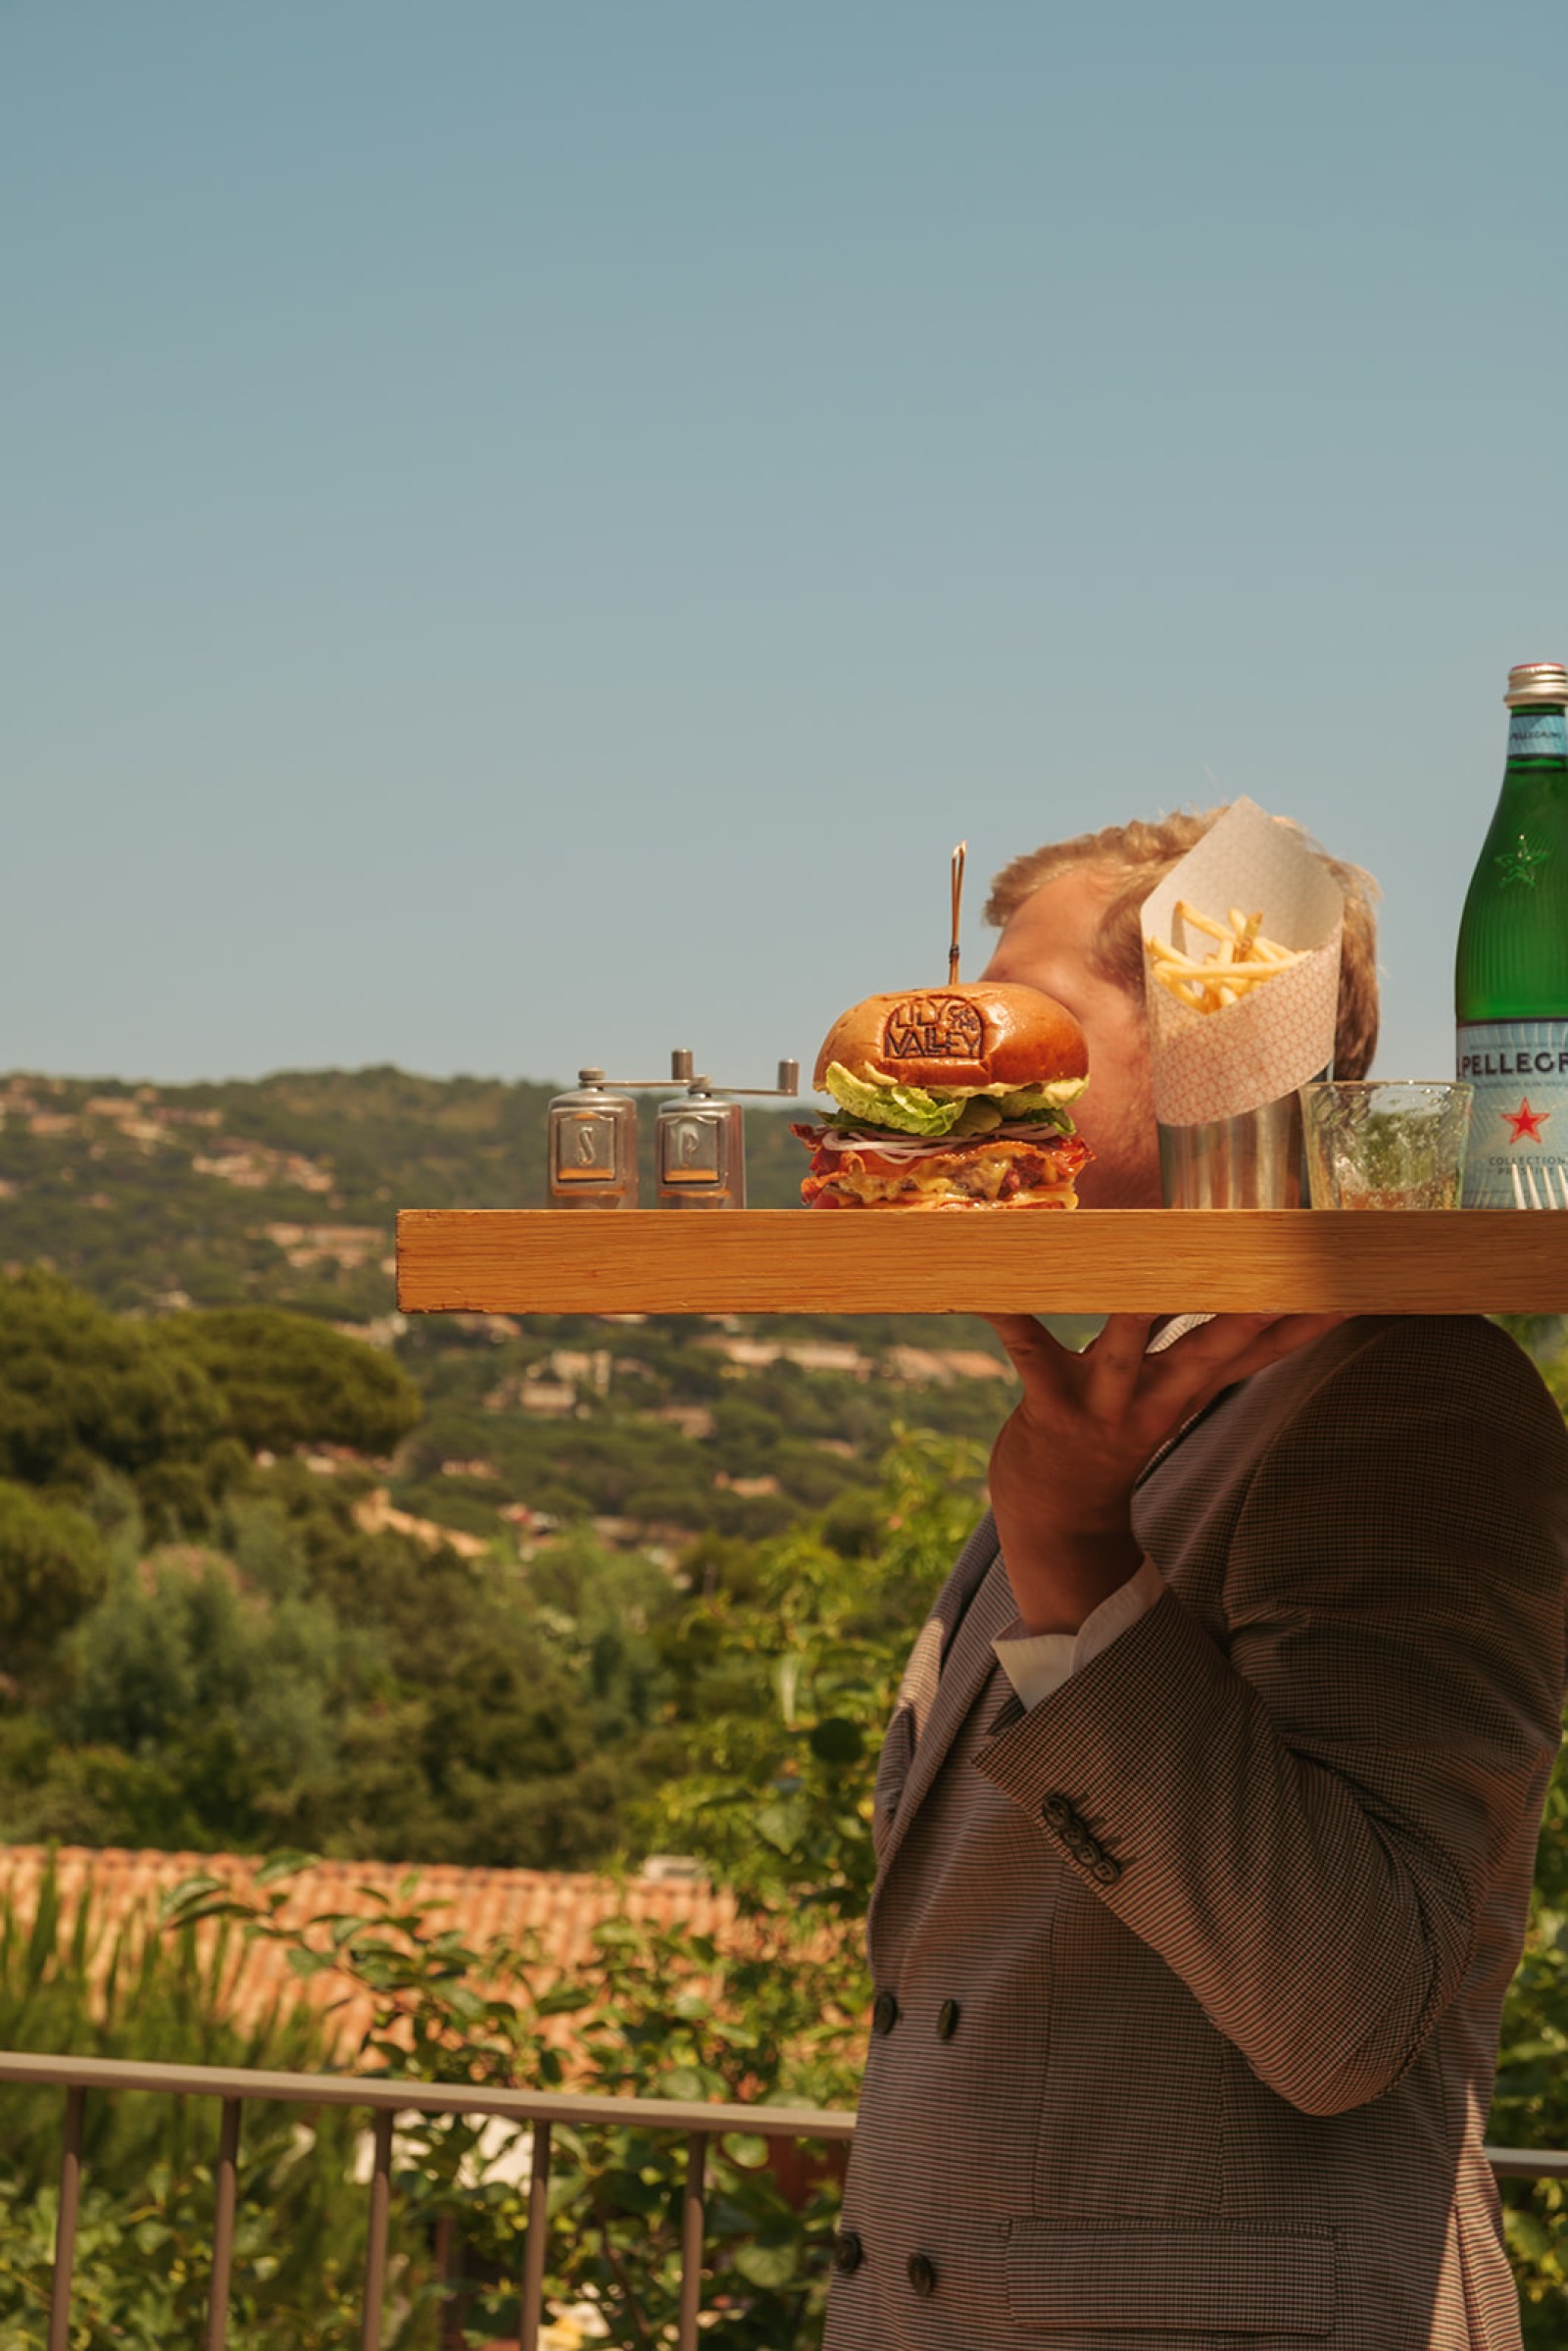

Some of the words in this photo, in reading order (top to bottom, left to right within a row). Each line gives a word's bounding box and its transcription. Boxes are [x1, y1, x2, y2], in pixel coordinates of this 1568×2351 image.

[886, 1026, 981, 1057] VALLEY
[577, 1125, 596, 1166] S
[678, 1124, 699, 1168] P
